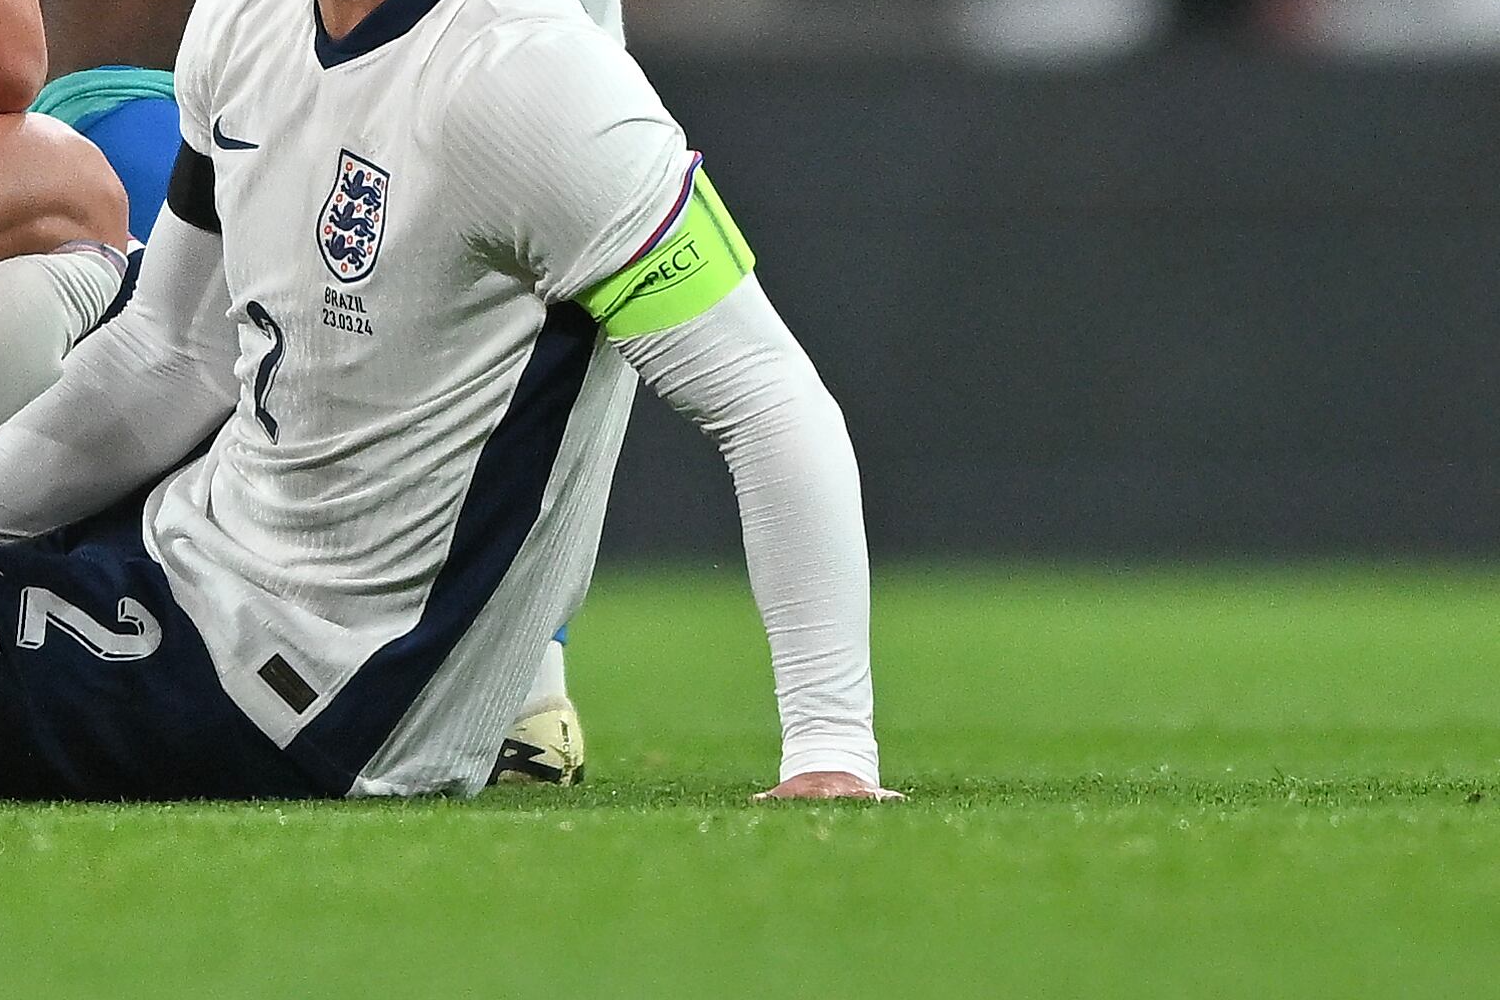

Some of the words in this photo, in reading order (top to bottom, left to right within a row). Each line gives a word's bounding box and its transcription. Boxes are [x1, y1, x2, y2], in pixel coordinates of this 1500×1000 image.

[324, 286, 367, 314] BRAZIL
[322, 307, 373, 336] 23.03.24
[16, 586, 163, 662] 2
